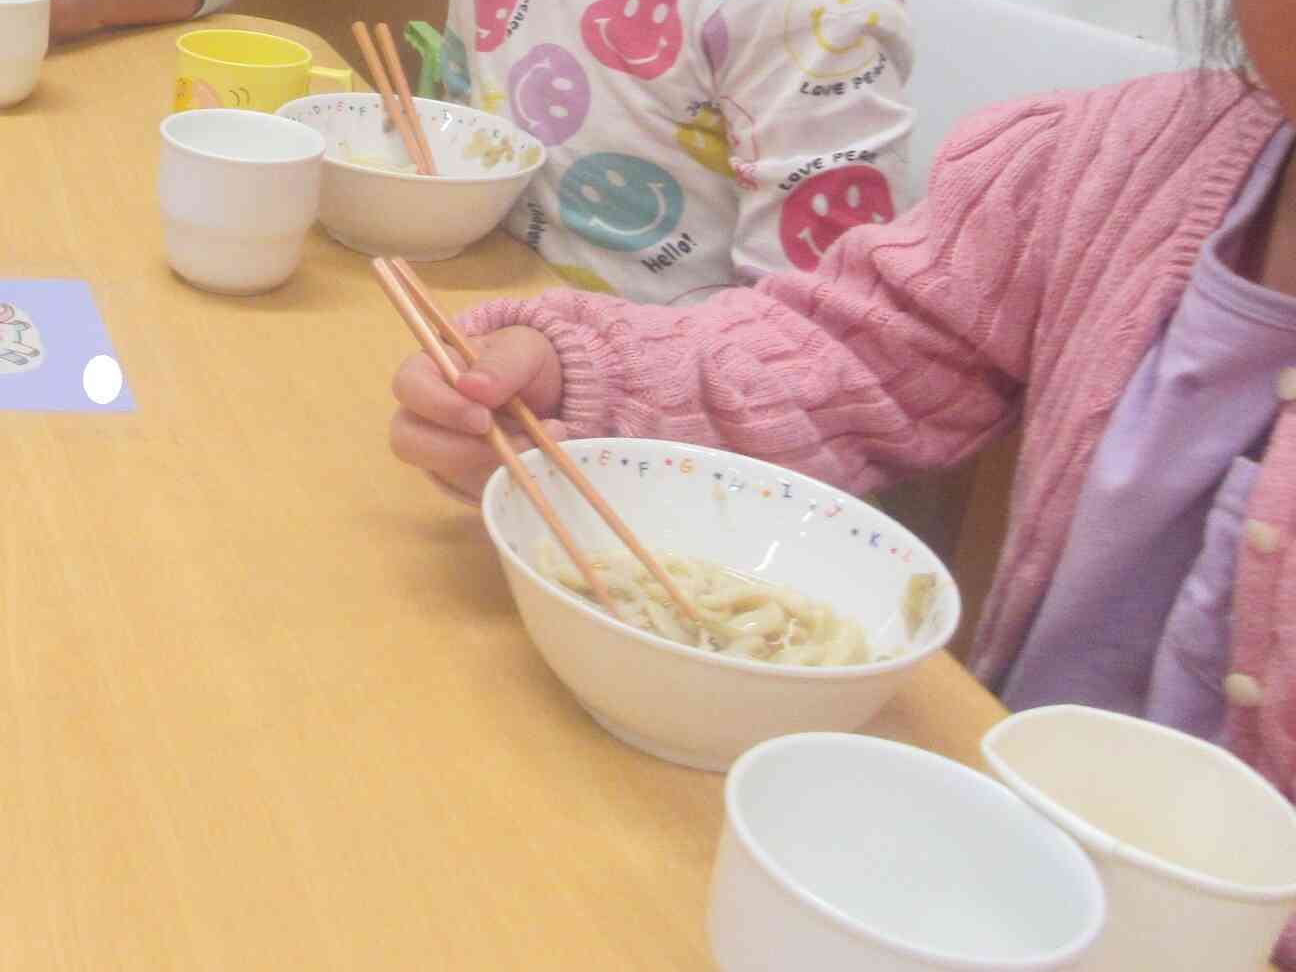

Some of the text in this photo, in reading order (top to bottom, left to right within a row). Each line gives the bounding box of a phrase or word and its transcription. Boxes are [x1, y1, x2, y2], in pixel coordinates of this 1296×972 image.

[799, 81, 846, 96] LOVE
[777, 157, 825, 191] LOVE
[640, 232, 698, 275] Hello!
[639, 461, 649, 478] F
[869, 531, 881, 548] K
